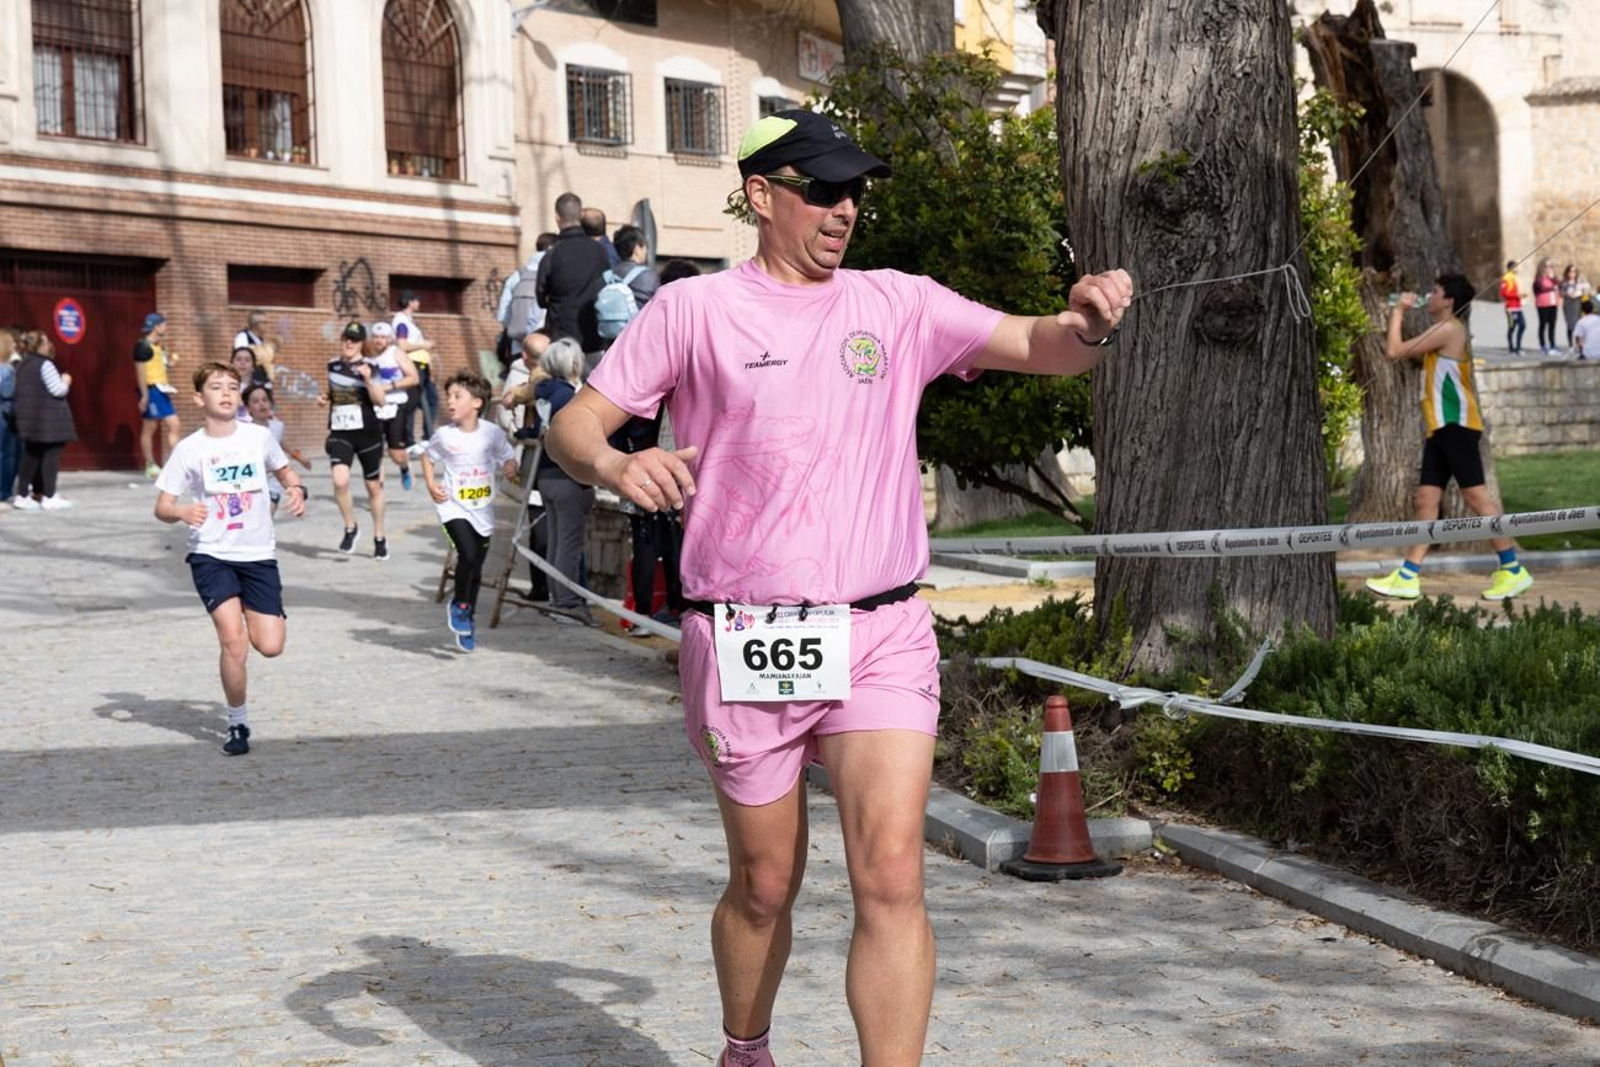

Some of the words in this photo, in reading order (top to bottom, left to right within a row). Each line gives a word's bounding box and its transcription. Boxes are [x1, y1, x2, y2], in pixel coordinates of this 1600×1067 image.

[744, 358, 789, 370] TEAMERGY
[215, 463, 254, 482] 274
[459, 485, 492, 500] 1209
[1176, 539, 1206, 551] DEPORTES
[1298, 531, 1333, 544] DEPORTES
[1355, 528, 1394, 541] Ayuntamiento
[1442, 517, 1482, 532] DEPORTES
[1509, 512, 1556, 527] Ayuntamiento
[1557, 511, 1566, 520] de
[743, 637, 823, 671] 665
